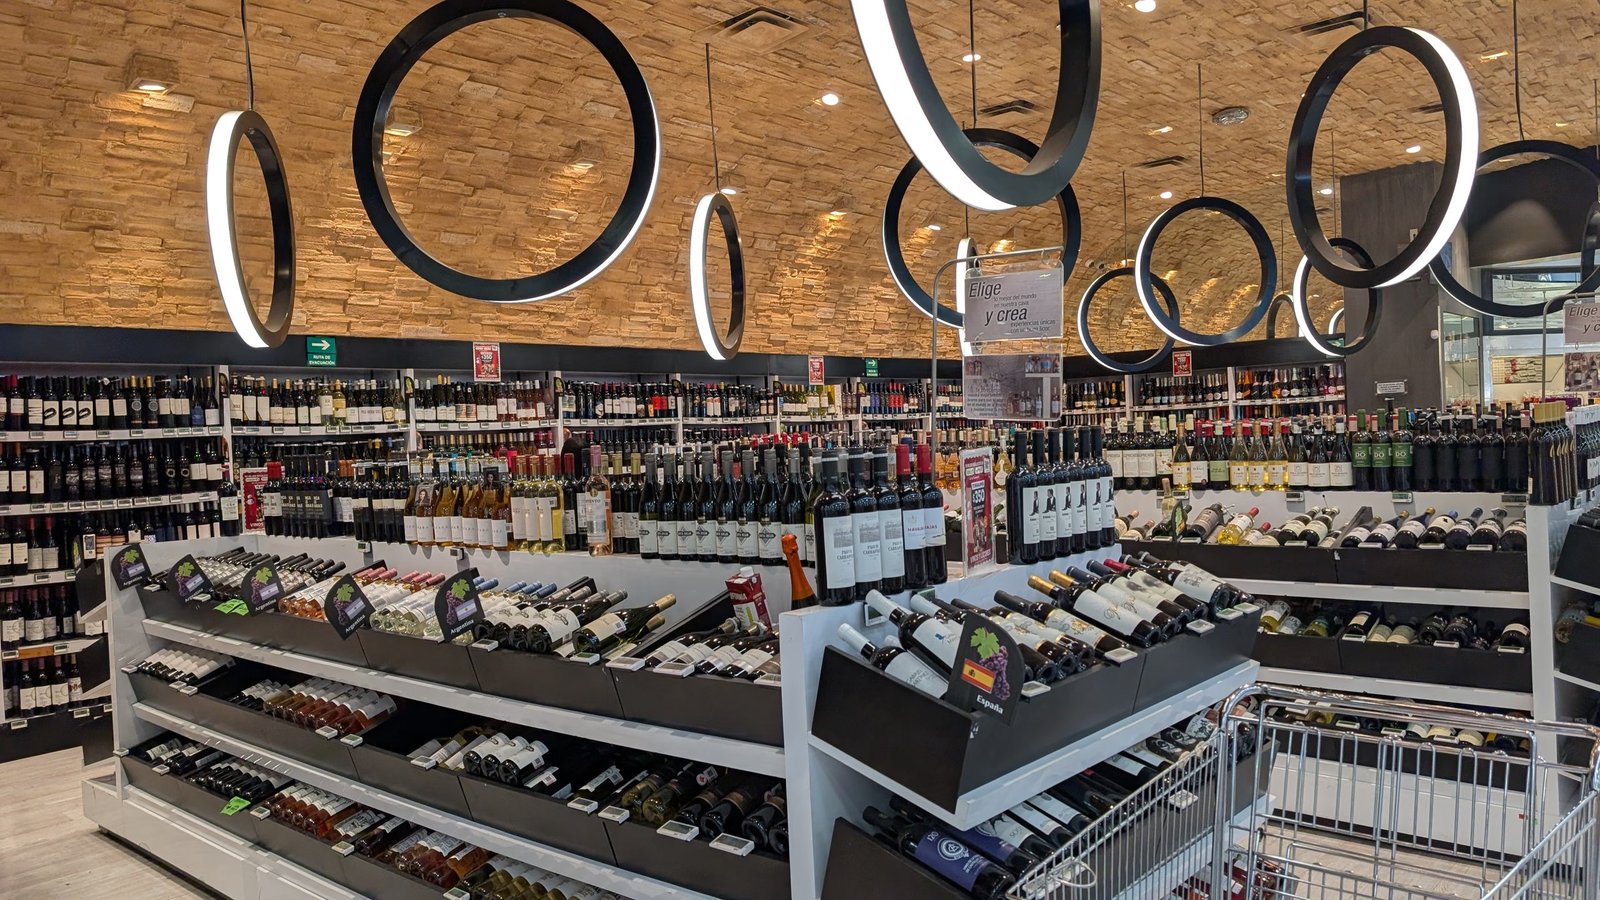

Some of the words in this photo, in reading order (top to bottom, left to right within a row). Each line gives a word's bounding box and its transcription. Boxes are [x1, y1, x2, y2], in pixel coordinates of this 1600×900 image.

[969, 282, 1001, 299] Elige
[984, 310, 994, 326] y
[997, 308, 1027, 322] crea
[1570, 306, 1598, 317] Elige
[1583, 324, 1590, 334] y
[346, 614, 366, 632] Argentina
[450, 620, 474, 634] Argentina
[976, 695, 1004, 714] España
